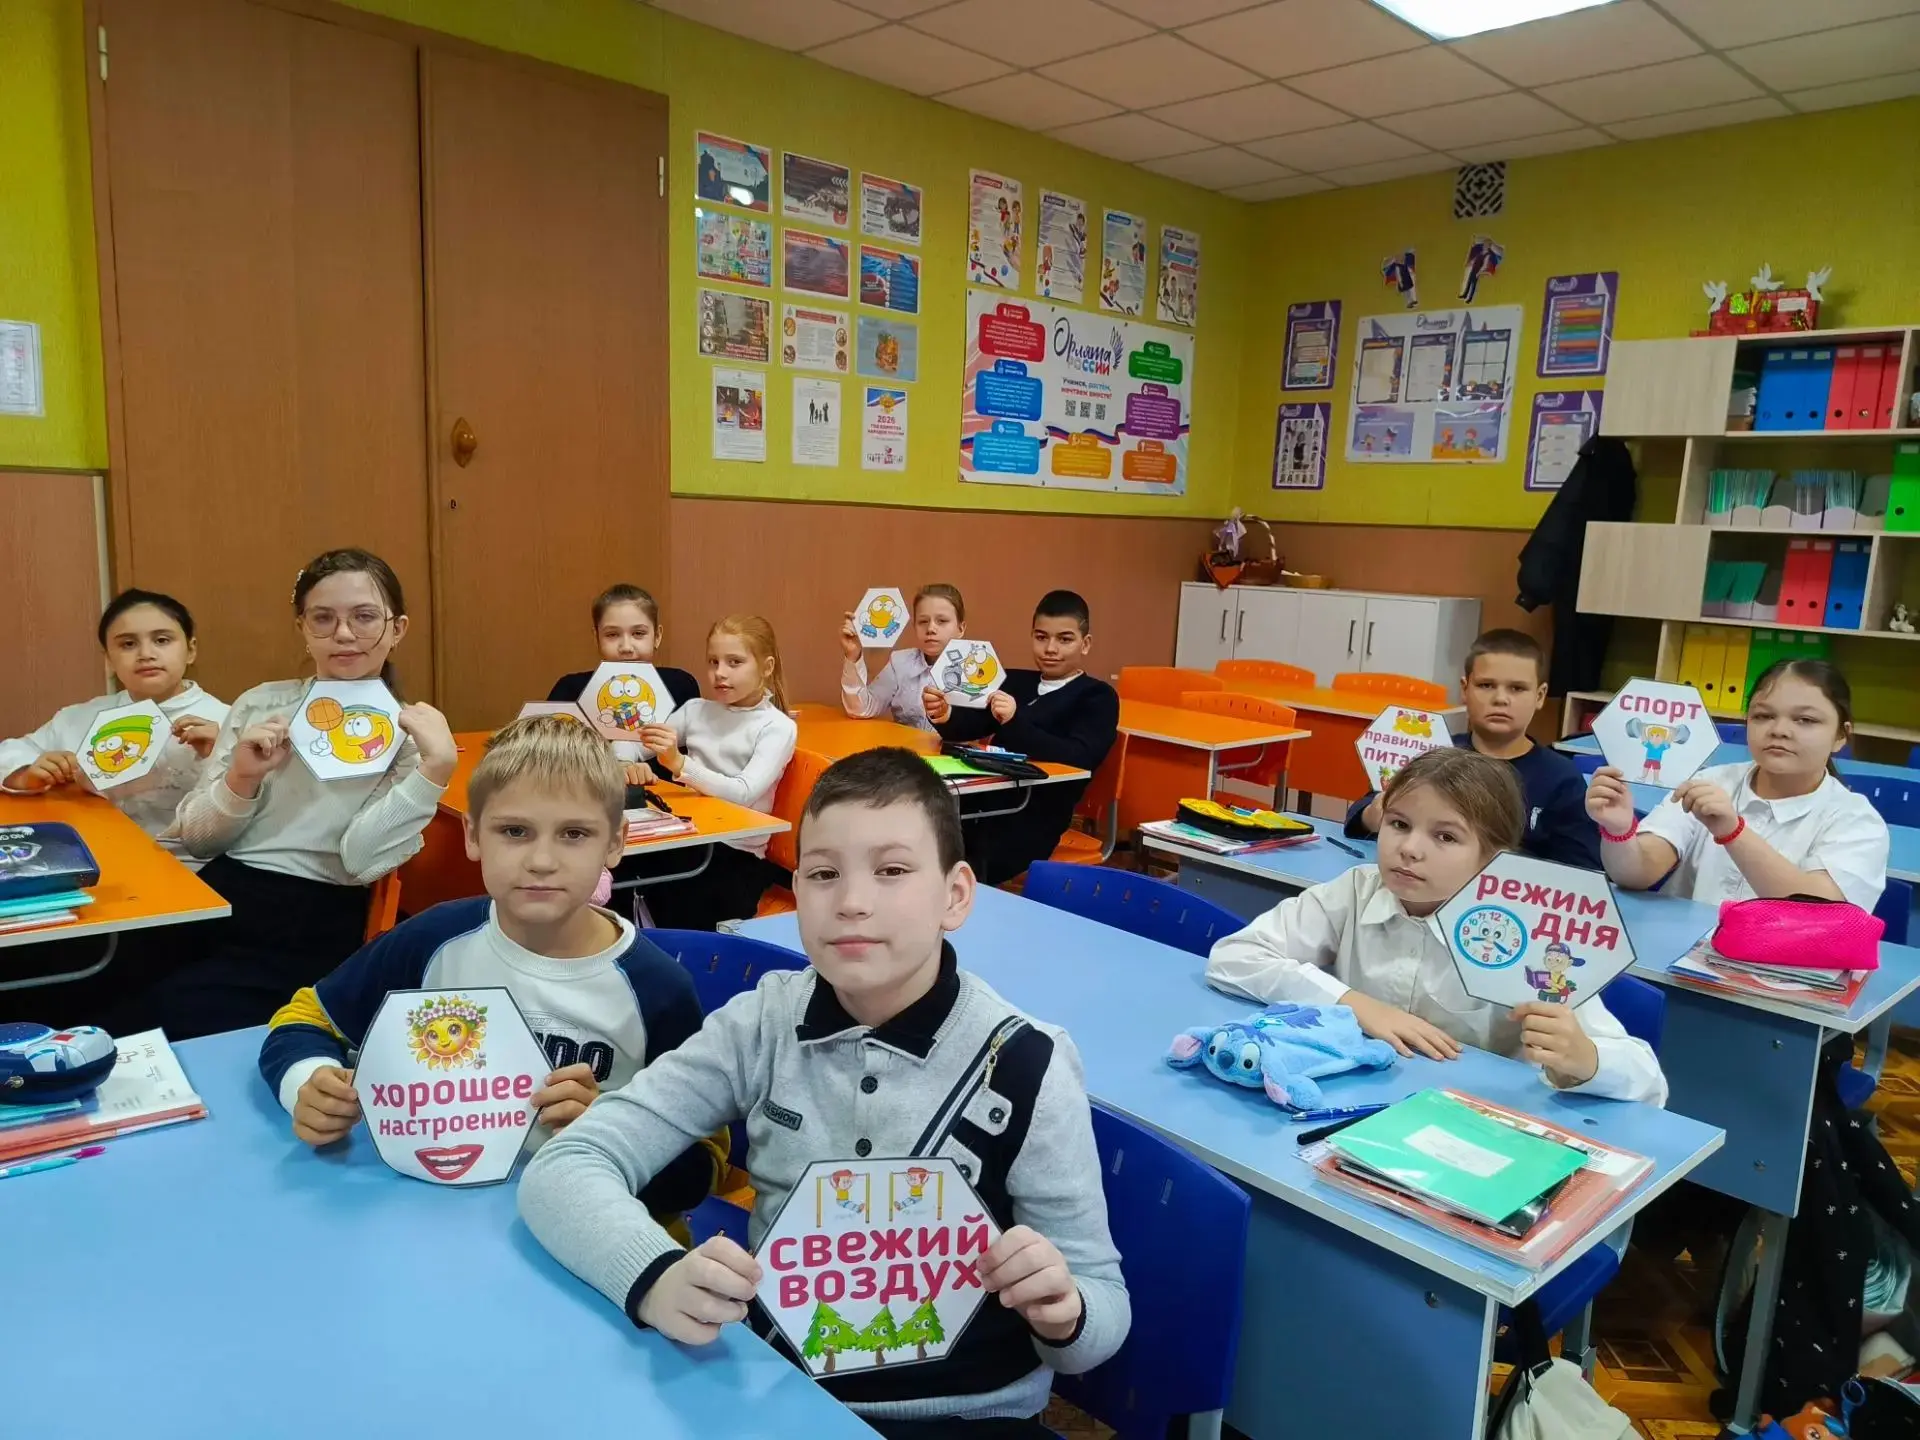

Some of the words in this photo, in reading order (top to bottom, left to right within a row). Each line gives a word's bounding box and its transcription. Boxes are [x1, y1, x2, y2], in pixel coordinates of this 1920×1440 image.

[1054, 317, 1111, 363] Орлята
[1067, 356, 1110, 376] РОССИИ
[1619, 694, 1702, 723] спорт
[1475, 873, 1607, 920] режим
[1530, 912, 1620, 950] дня
[371, 1074, 533, 1117] хорошее
[379, 1109, 527, 1140] настроение
[769, 1213, 989, 1272] свежий
[779, 1259, 984, 1309] воздух
